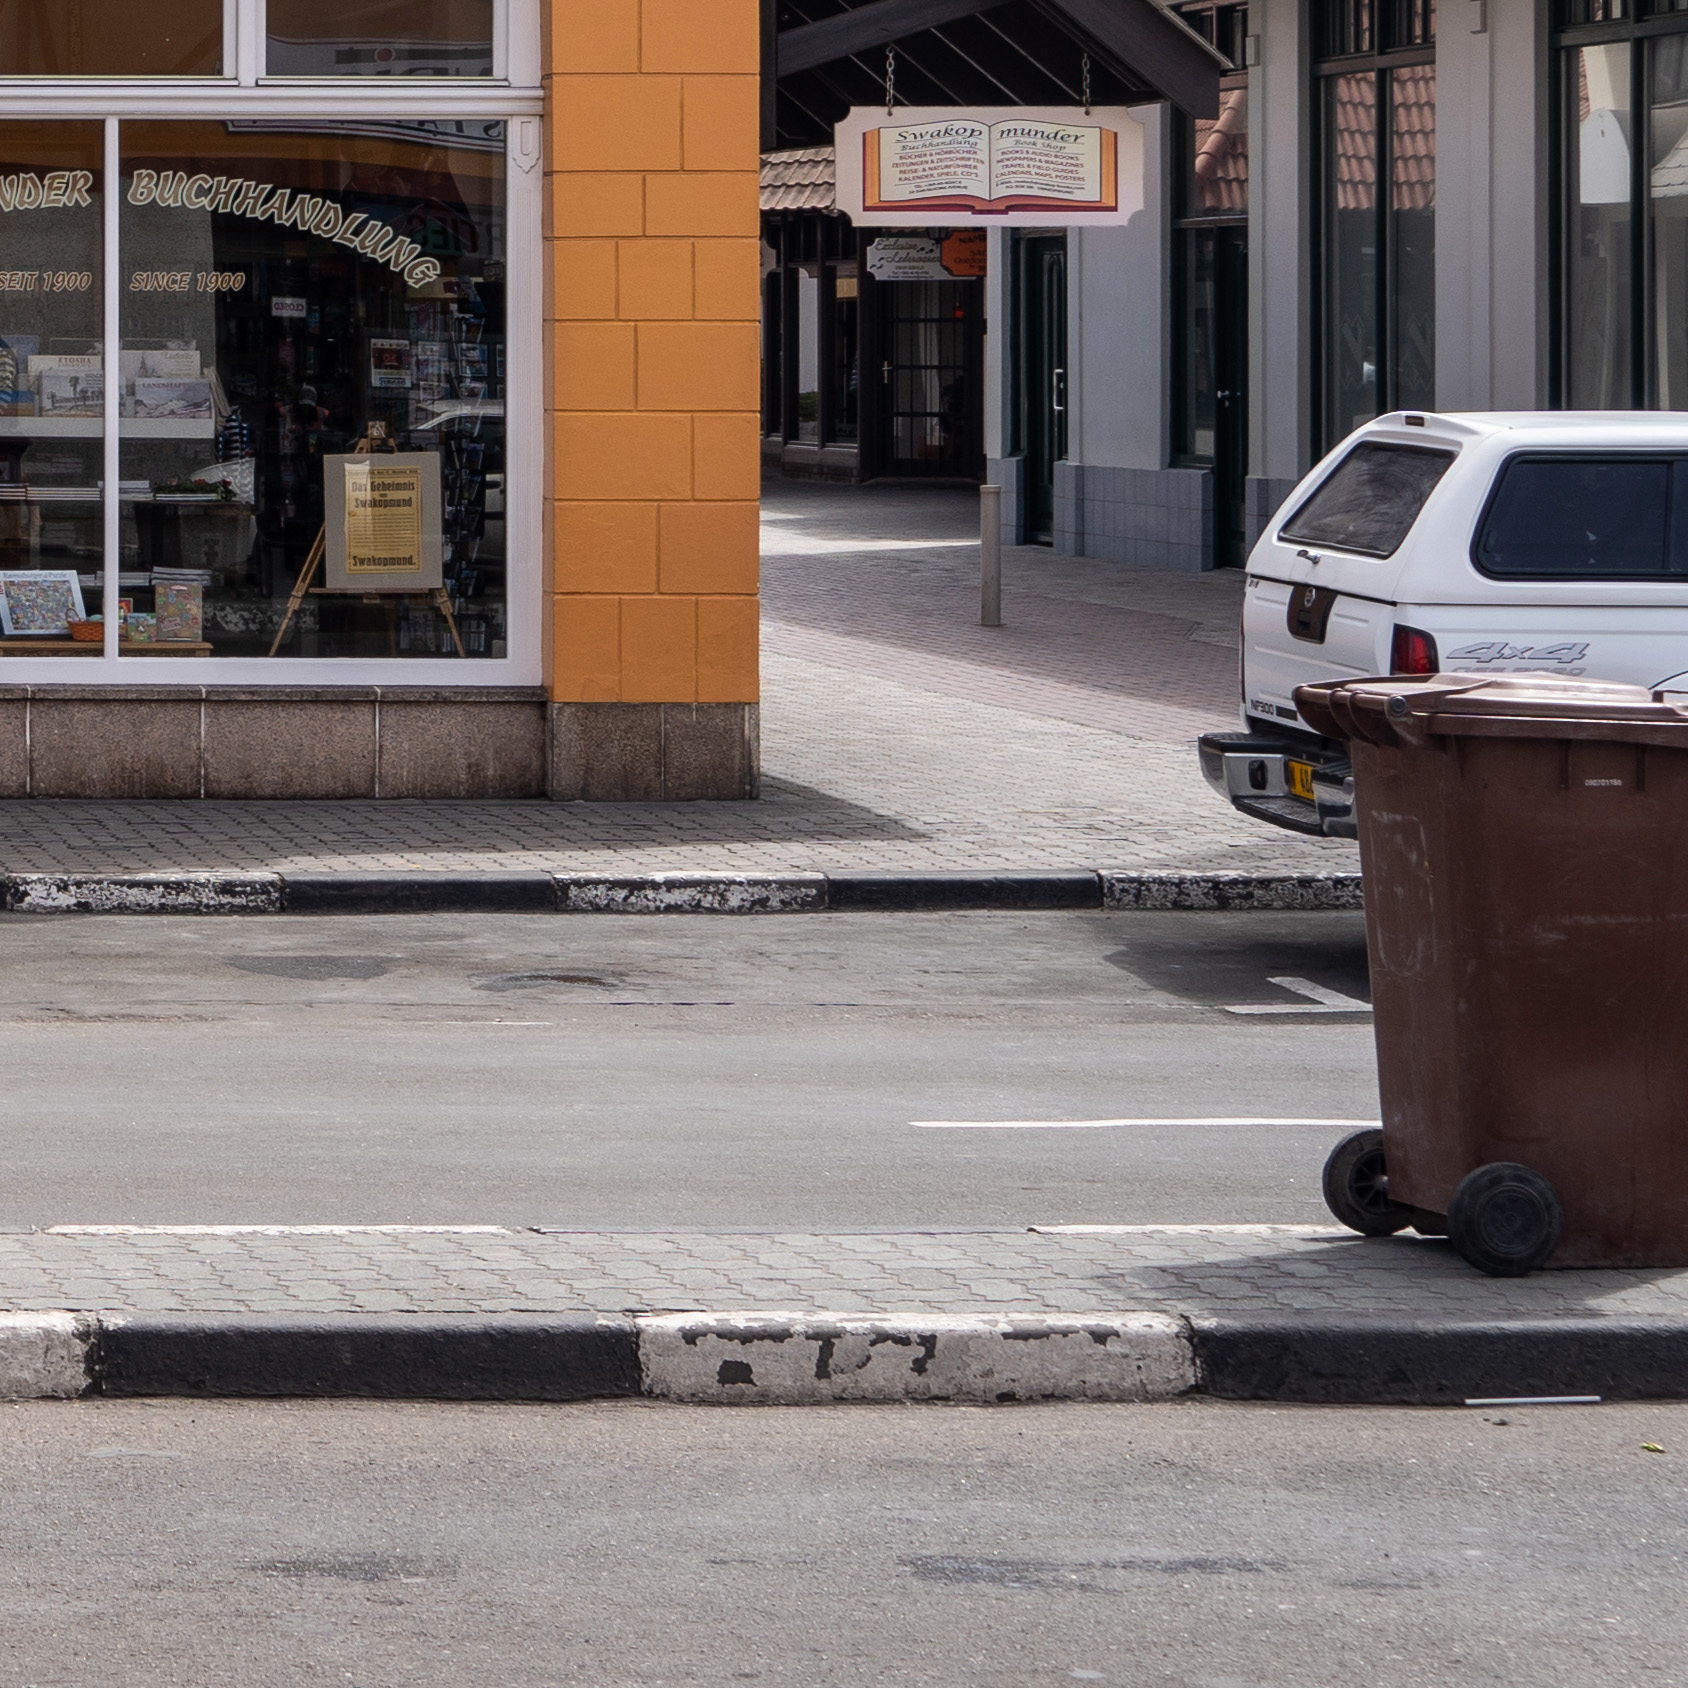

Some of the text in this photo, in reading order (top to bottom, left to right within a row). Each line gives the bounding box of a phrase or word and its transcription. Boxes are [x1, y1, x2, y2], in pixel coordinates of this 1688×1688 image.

[895, 124, 983, 142] Swakop
[998, 127, 1086, 143] munder
[1041, 140, 1067, 152] Shop
[126, 169, 444, 290] BUCHHANDLUNG
[41, 270, 93, 292] 1900
[129, 270, 192, 292] SINCE
[195, 270, 246, 292] 1900
[370, 480, 415, 492] Geheimnis
[354, 497, 413, 509] Swakopmund
[352, 555, 417, 568] Swakopmund.
[1446, 641, 1590, 664] 4x4
[1250, 698, 1274, 716] NP300
